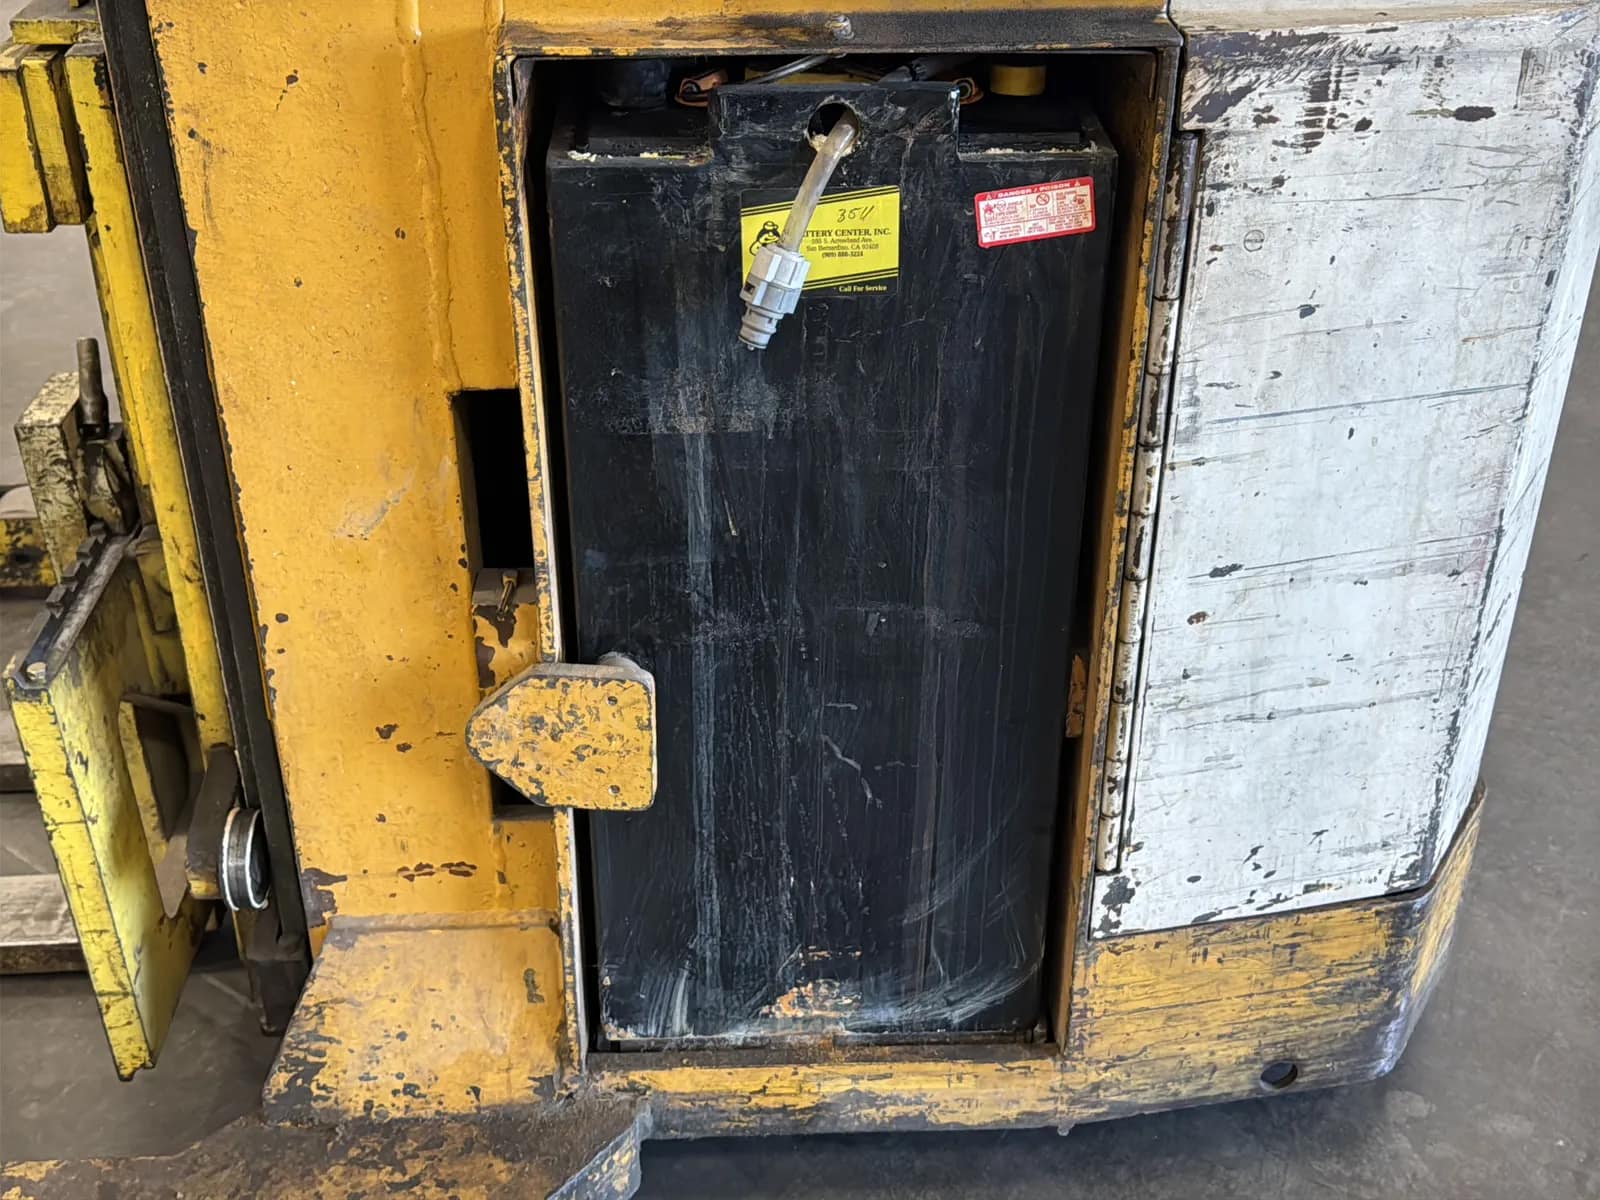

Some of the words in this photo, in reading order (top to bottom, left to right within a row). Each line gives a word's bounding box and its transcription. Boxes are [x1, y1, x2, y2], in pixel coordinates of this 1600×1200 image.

[997, 188, 1032, 197] DANGER
[1038, 182, 1071, 192] POISON
[803, 229, 833, 238] TTERY
[874, 228, 891, 236] INC.
[865, 284, 887, 292] Service
